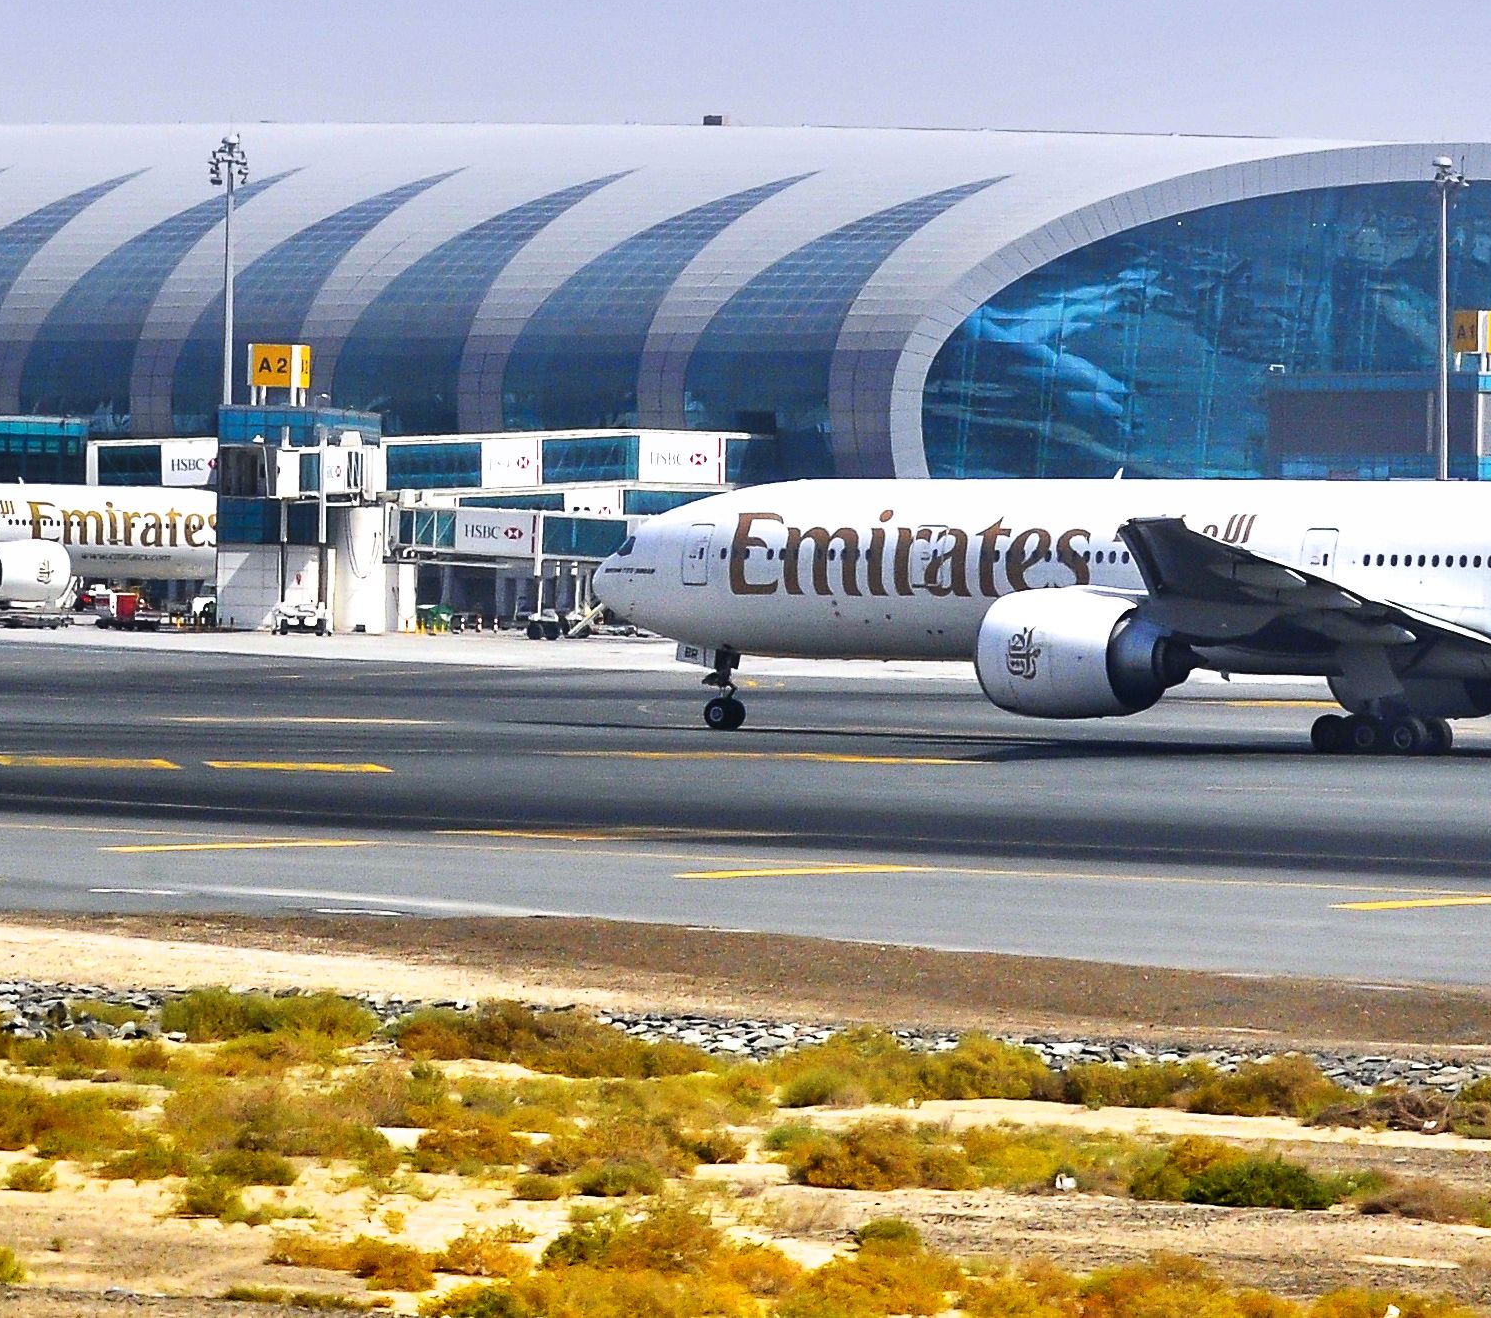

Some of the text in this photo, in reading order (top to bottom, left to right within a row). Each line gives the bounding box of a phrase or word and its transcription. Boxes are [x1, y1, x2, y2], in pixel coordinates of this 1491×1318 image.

[171, 457, 205, 472] HSBC
[464, 524, 501, 540] HSBC
[728, 509, 1091, 598] Emirates
